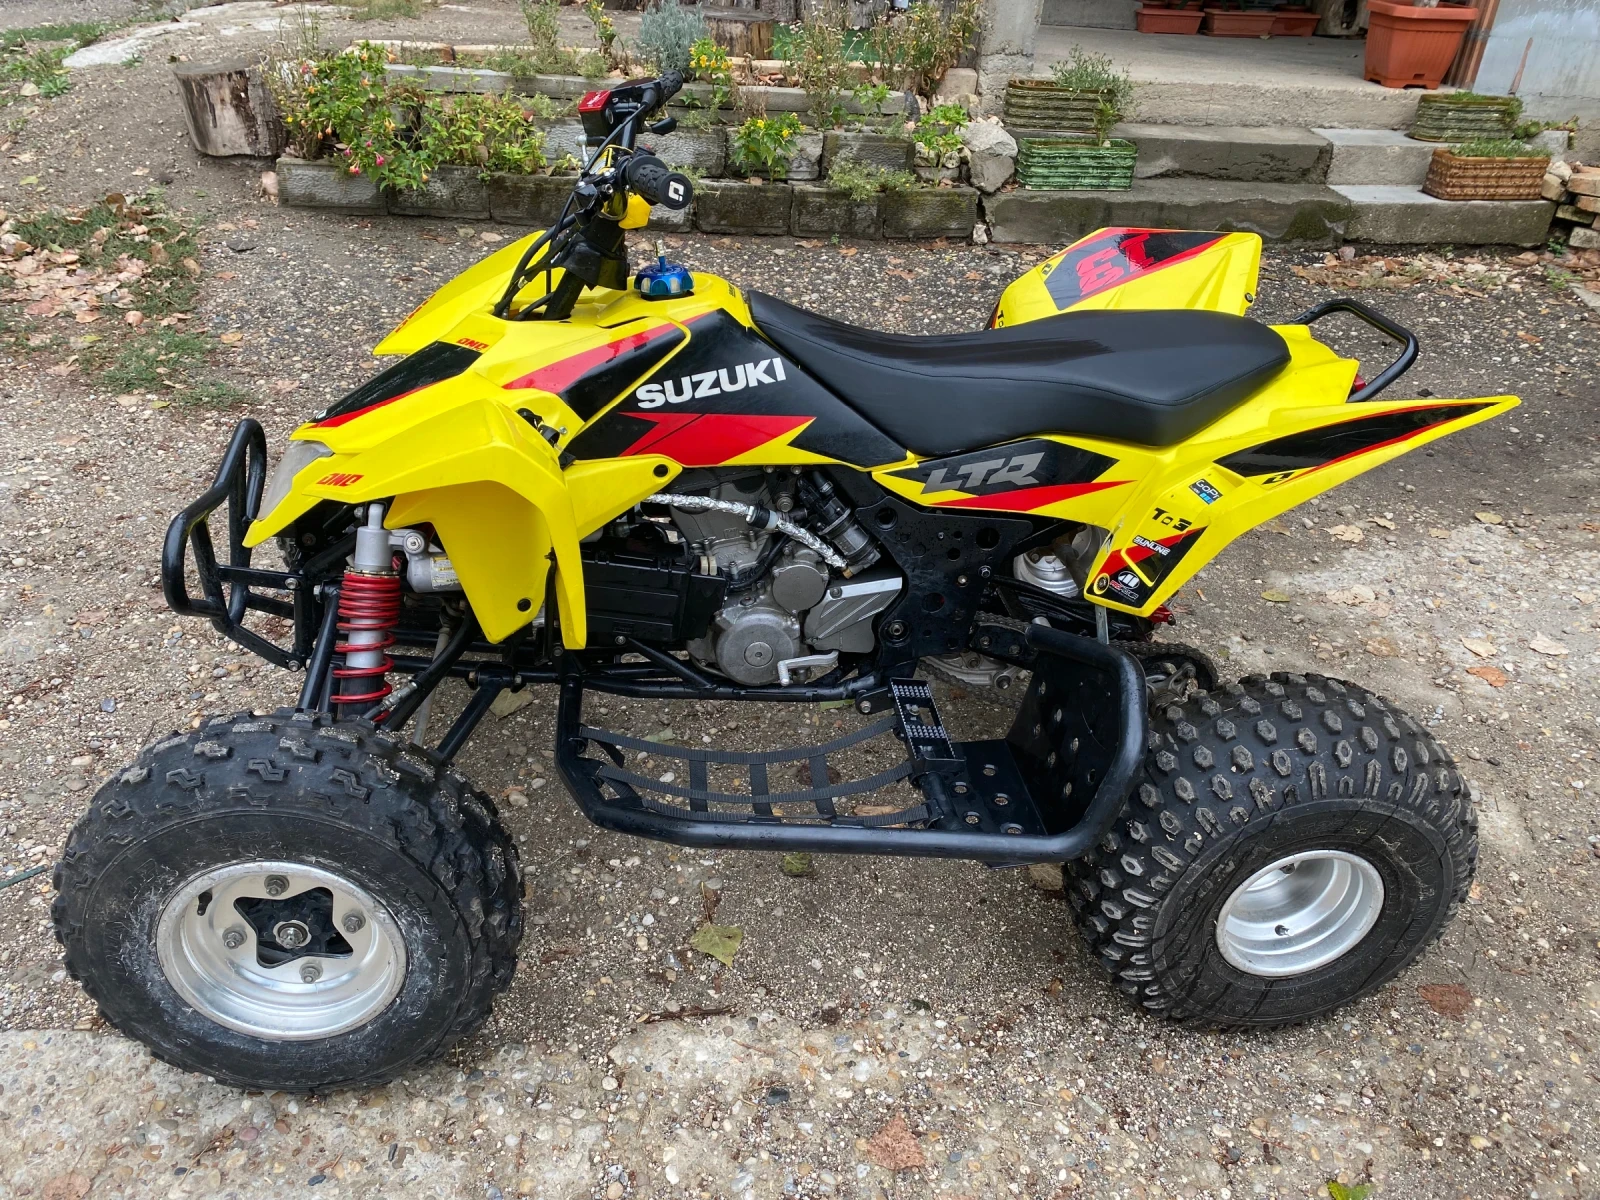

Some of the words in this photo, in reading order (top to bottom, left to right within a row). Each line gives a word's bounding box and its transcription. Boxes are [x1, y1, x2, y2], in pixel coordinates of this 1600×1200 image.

[635, 357, 787, 409] SUZUKI
[920, 452, 1045, 494] LTR
[1132, 535, 1171, 556] SUNLINE
